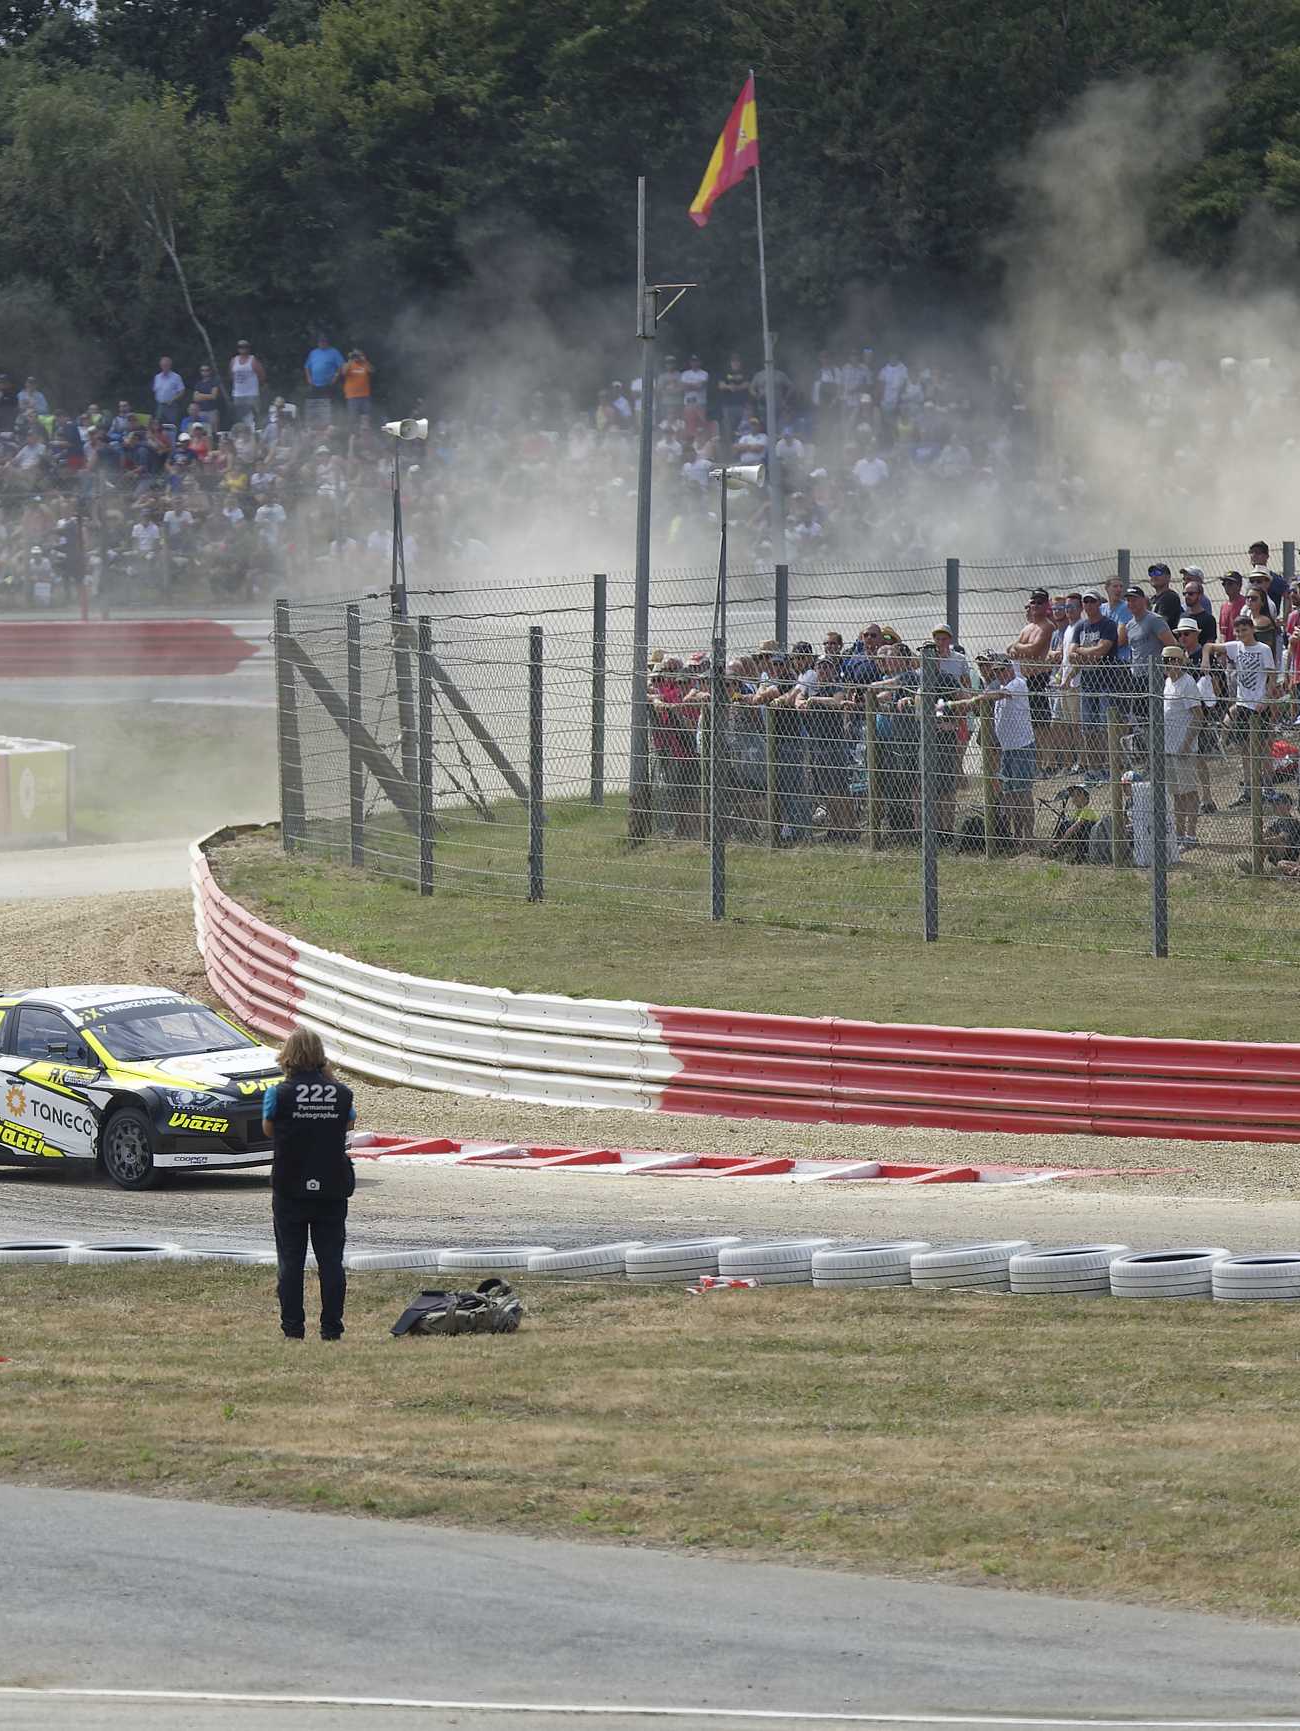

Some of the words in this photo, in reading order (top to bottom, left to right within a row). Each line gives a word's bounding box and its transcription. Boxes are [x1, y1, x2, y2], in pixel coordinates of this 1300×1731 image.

[296, 1084, 337, 1102] 222
[168, 1112, 229, 1133] Viatti
[292, 1111, 339, 1119] Photographer
